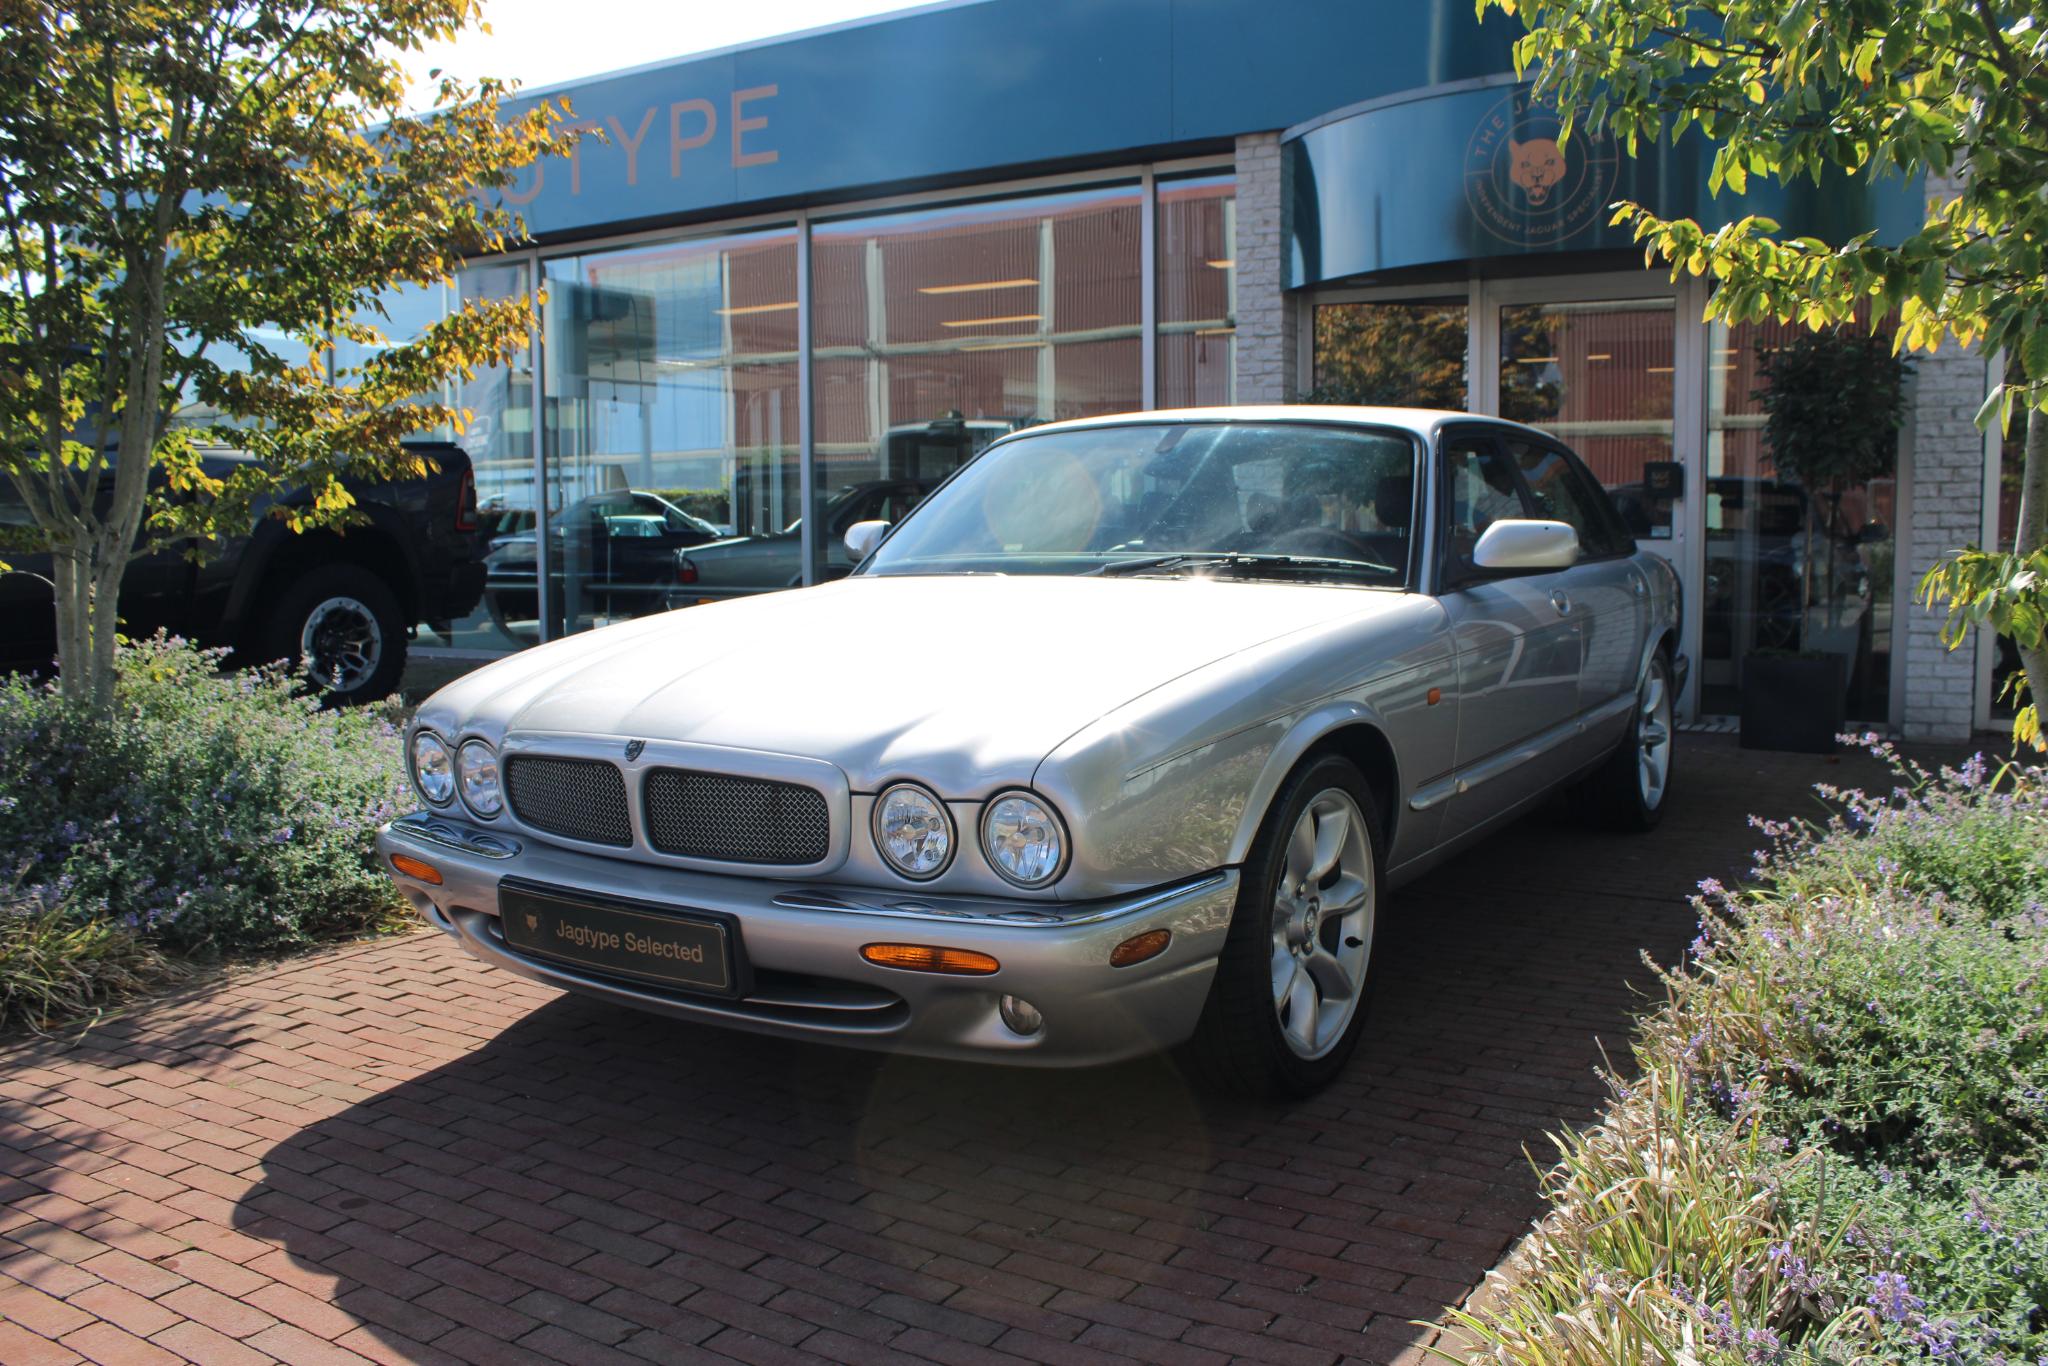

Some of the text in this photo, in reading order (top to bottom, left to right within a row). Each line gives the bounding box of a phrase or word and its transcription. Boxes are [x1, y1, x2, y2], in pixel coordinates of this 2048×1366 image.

[466, 84, 779, 209] TYPE
[1475, 115, 1505, 157] THE
[556, 919, 704, 964] Jagtype Selected
